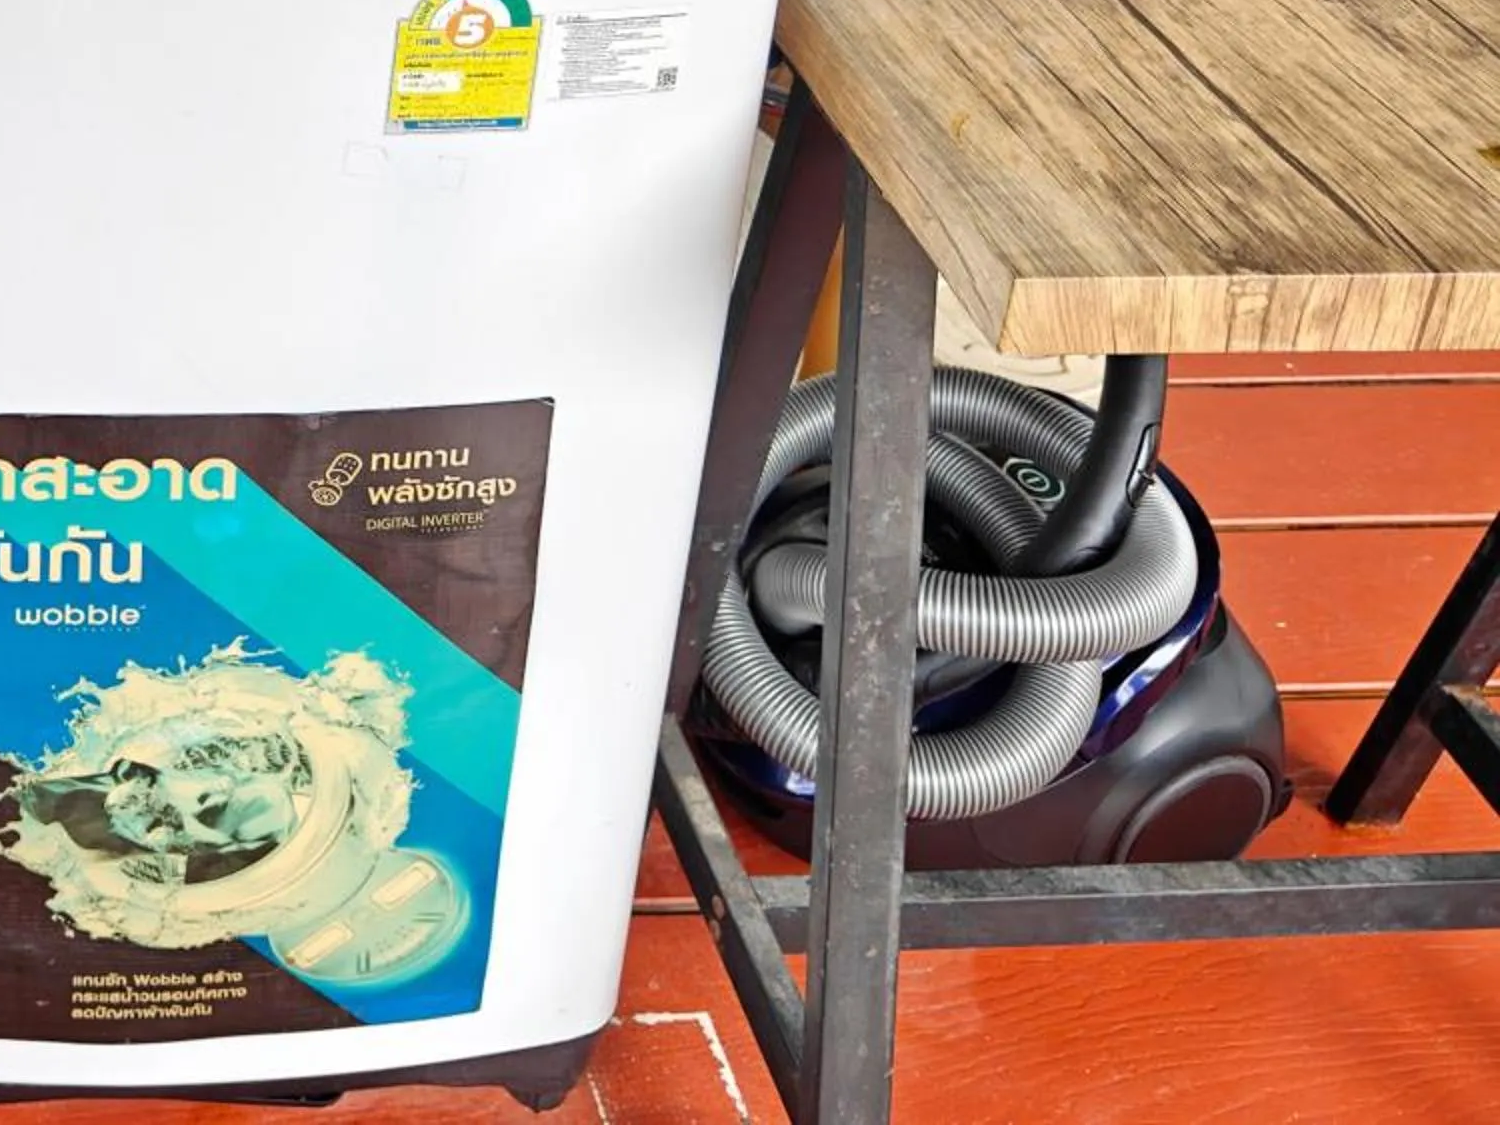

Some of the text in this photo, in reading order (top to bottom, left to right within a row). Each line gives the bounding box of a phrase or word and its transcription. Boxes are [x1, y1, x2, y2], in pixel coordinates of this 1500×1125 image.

[370, 446, 470, 472] ทนทาน
[367, 474, 518, 506] พลังซักสูง
[365, 515, 419, 532] DIGITAL
[420, 511, 485, 527] INVERTER
[14, 603, 142, 626] wobble
[133, 973, 197, 986] Wobble
